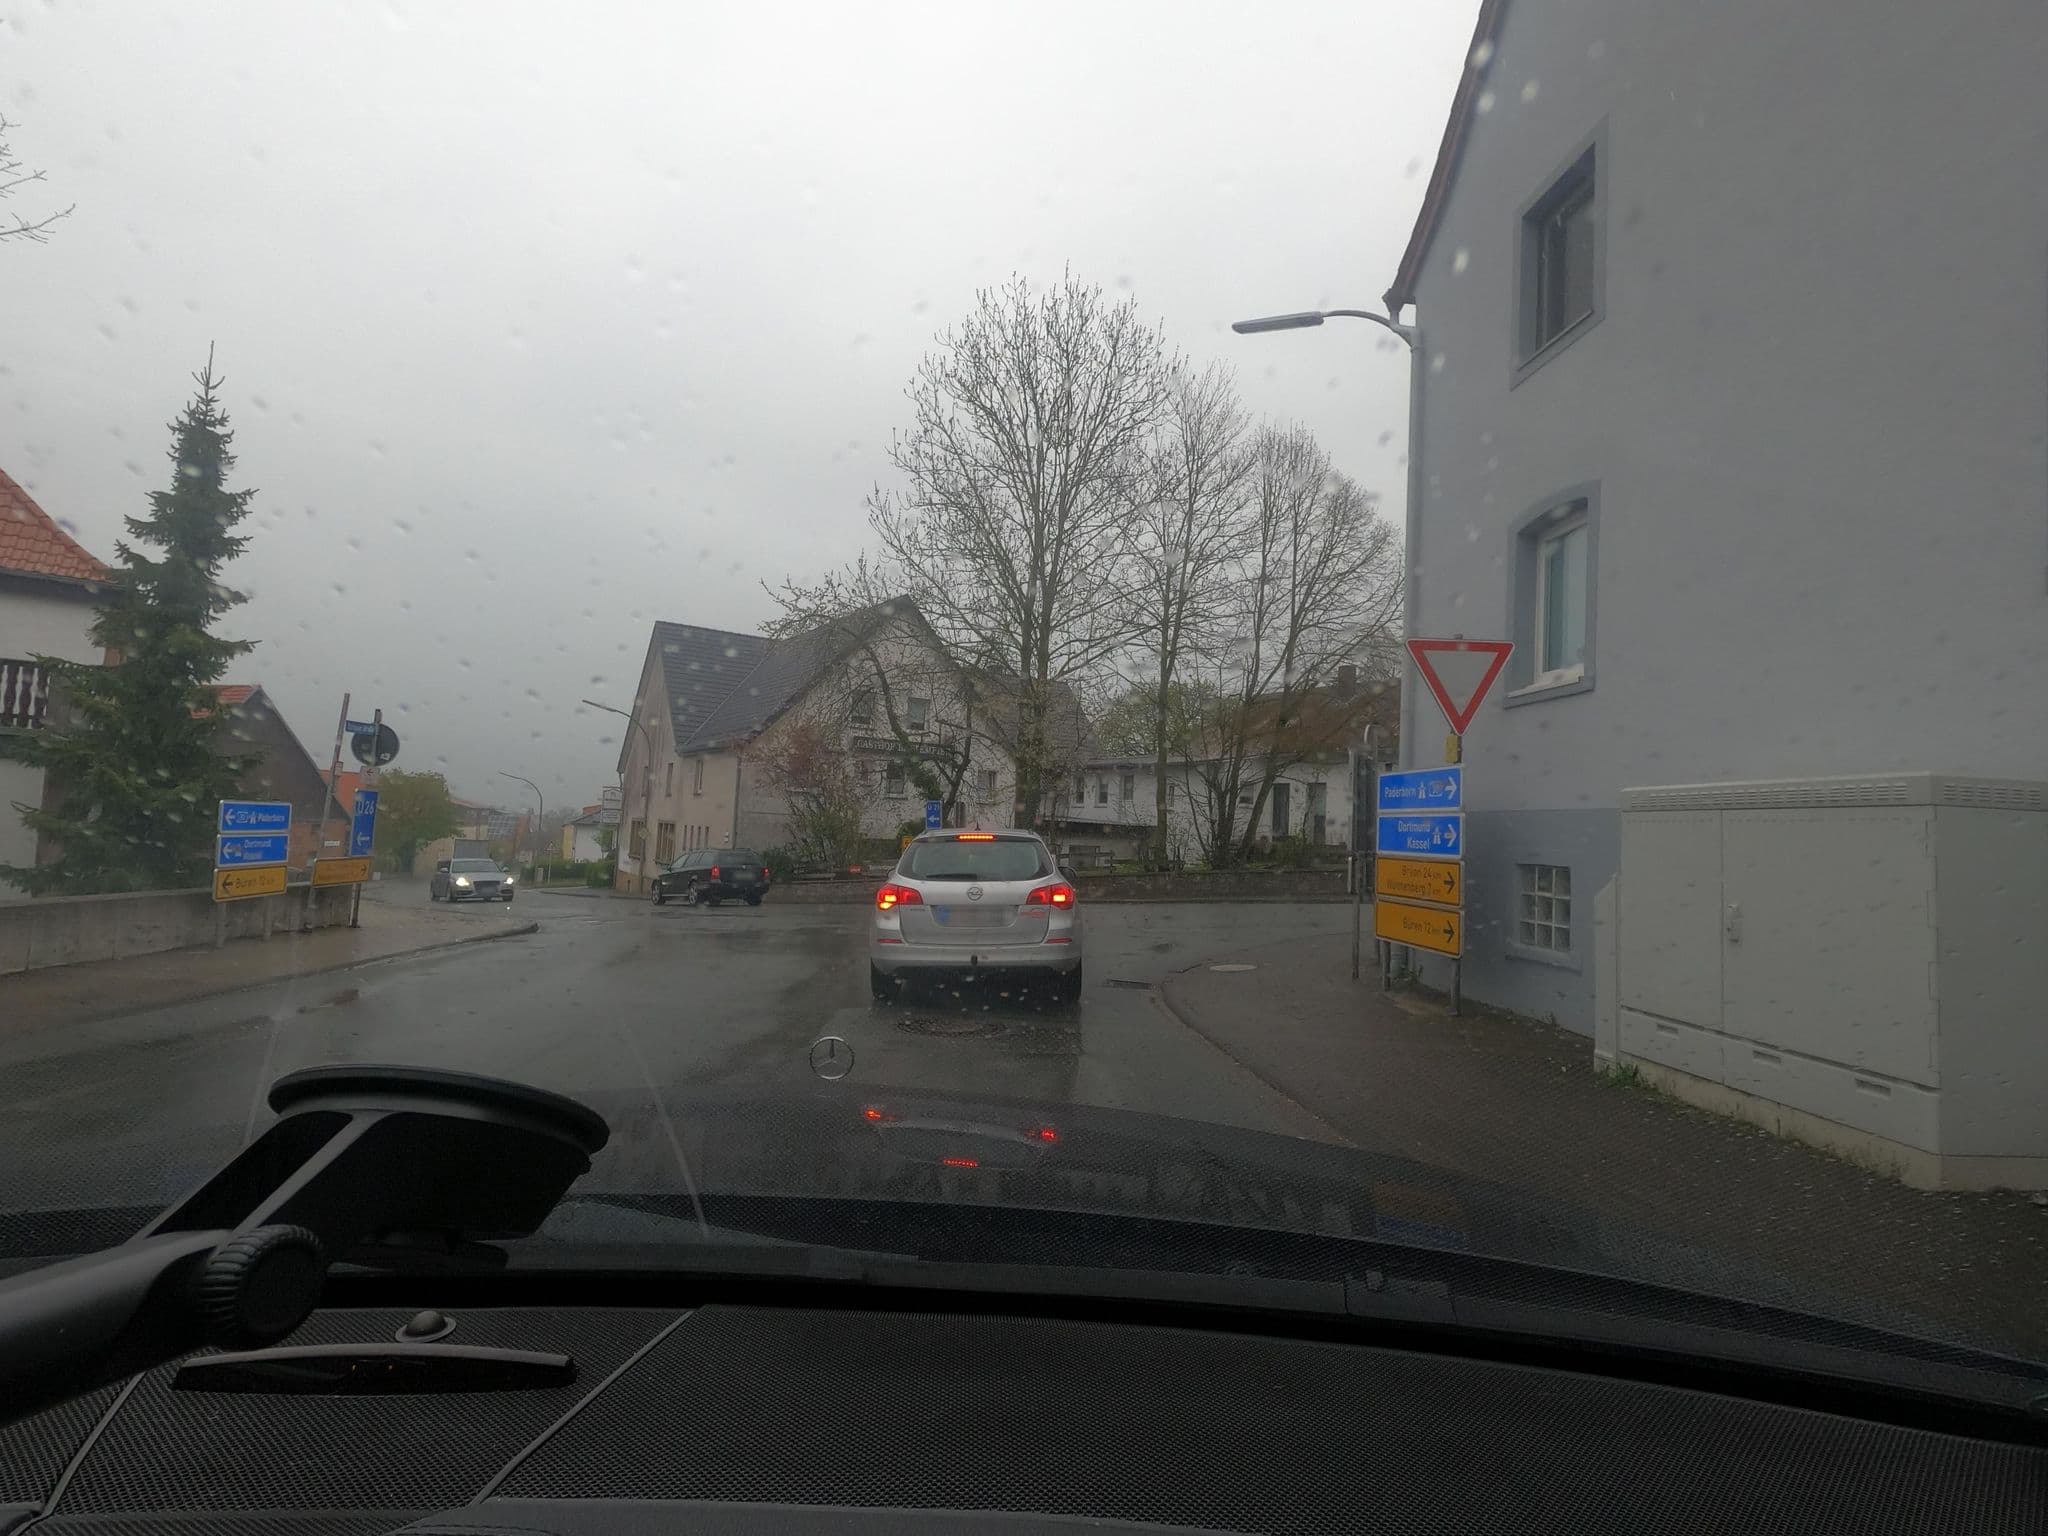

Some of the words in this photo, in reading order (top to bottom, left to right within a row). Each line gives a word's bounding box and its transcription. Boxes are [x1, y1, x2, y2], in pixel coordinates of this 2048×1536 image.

[857, 739, 895, 752] GASTHOF
[1398, 820, 1431, 833] Dortmund
[1407, 836, 1430, 850] Kassel
